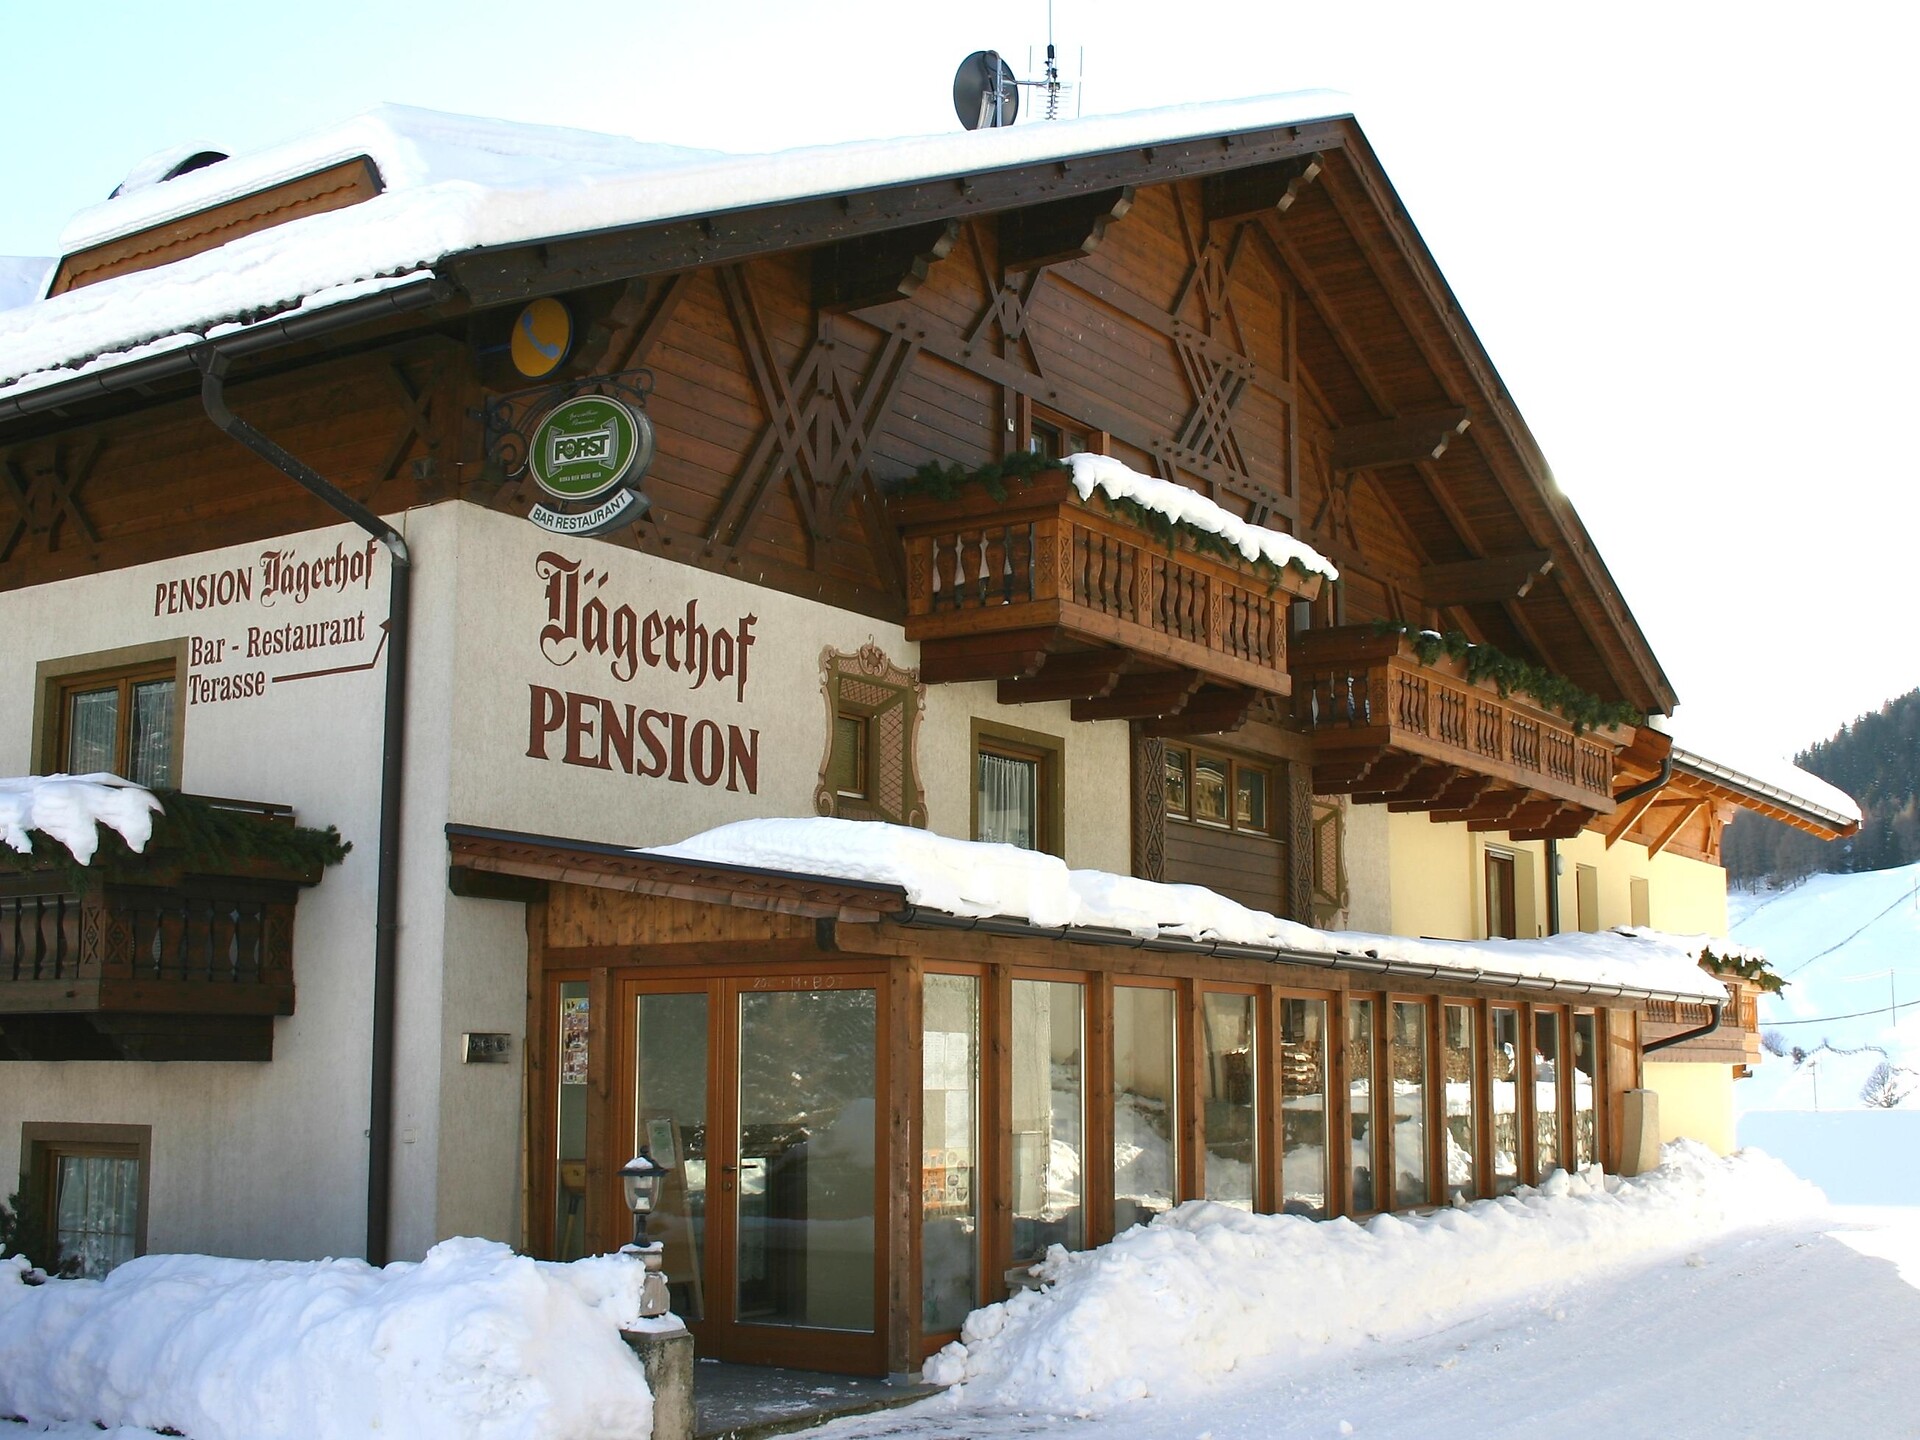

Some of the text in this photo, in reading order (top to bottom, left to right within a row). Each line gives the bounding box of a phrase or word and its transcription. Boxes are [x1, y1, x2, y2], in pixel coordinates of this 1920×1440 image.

[554, 434, 609, 460] FORST
[532, 493, 627, 530] BAR RESTAURANT
[154, 537, 379, 616] PENSION Jägerhof
[189, 636, 226, 667] Bar
[246, 610, 365, 658] Restaurant
[535, 551, 758, 703] Jägerhof
[188, 670, 265, 705] Terasse
[525, 683, 760, 795] PENSION
